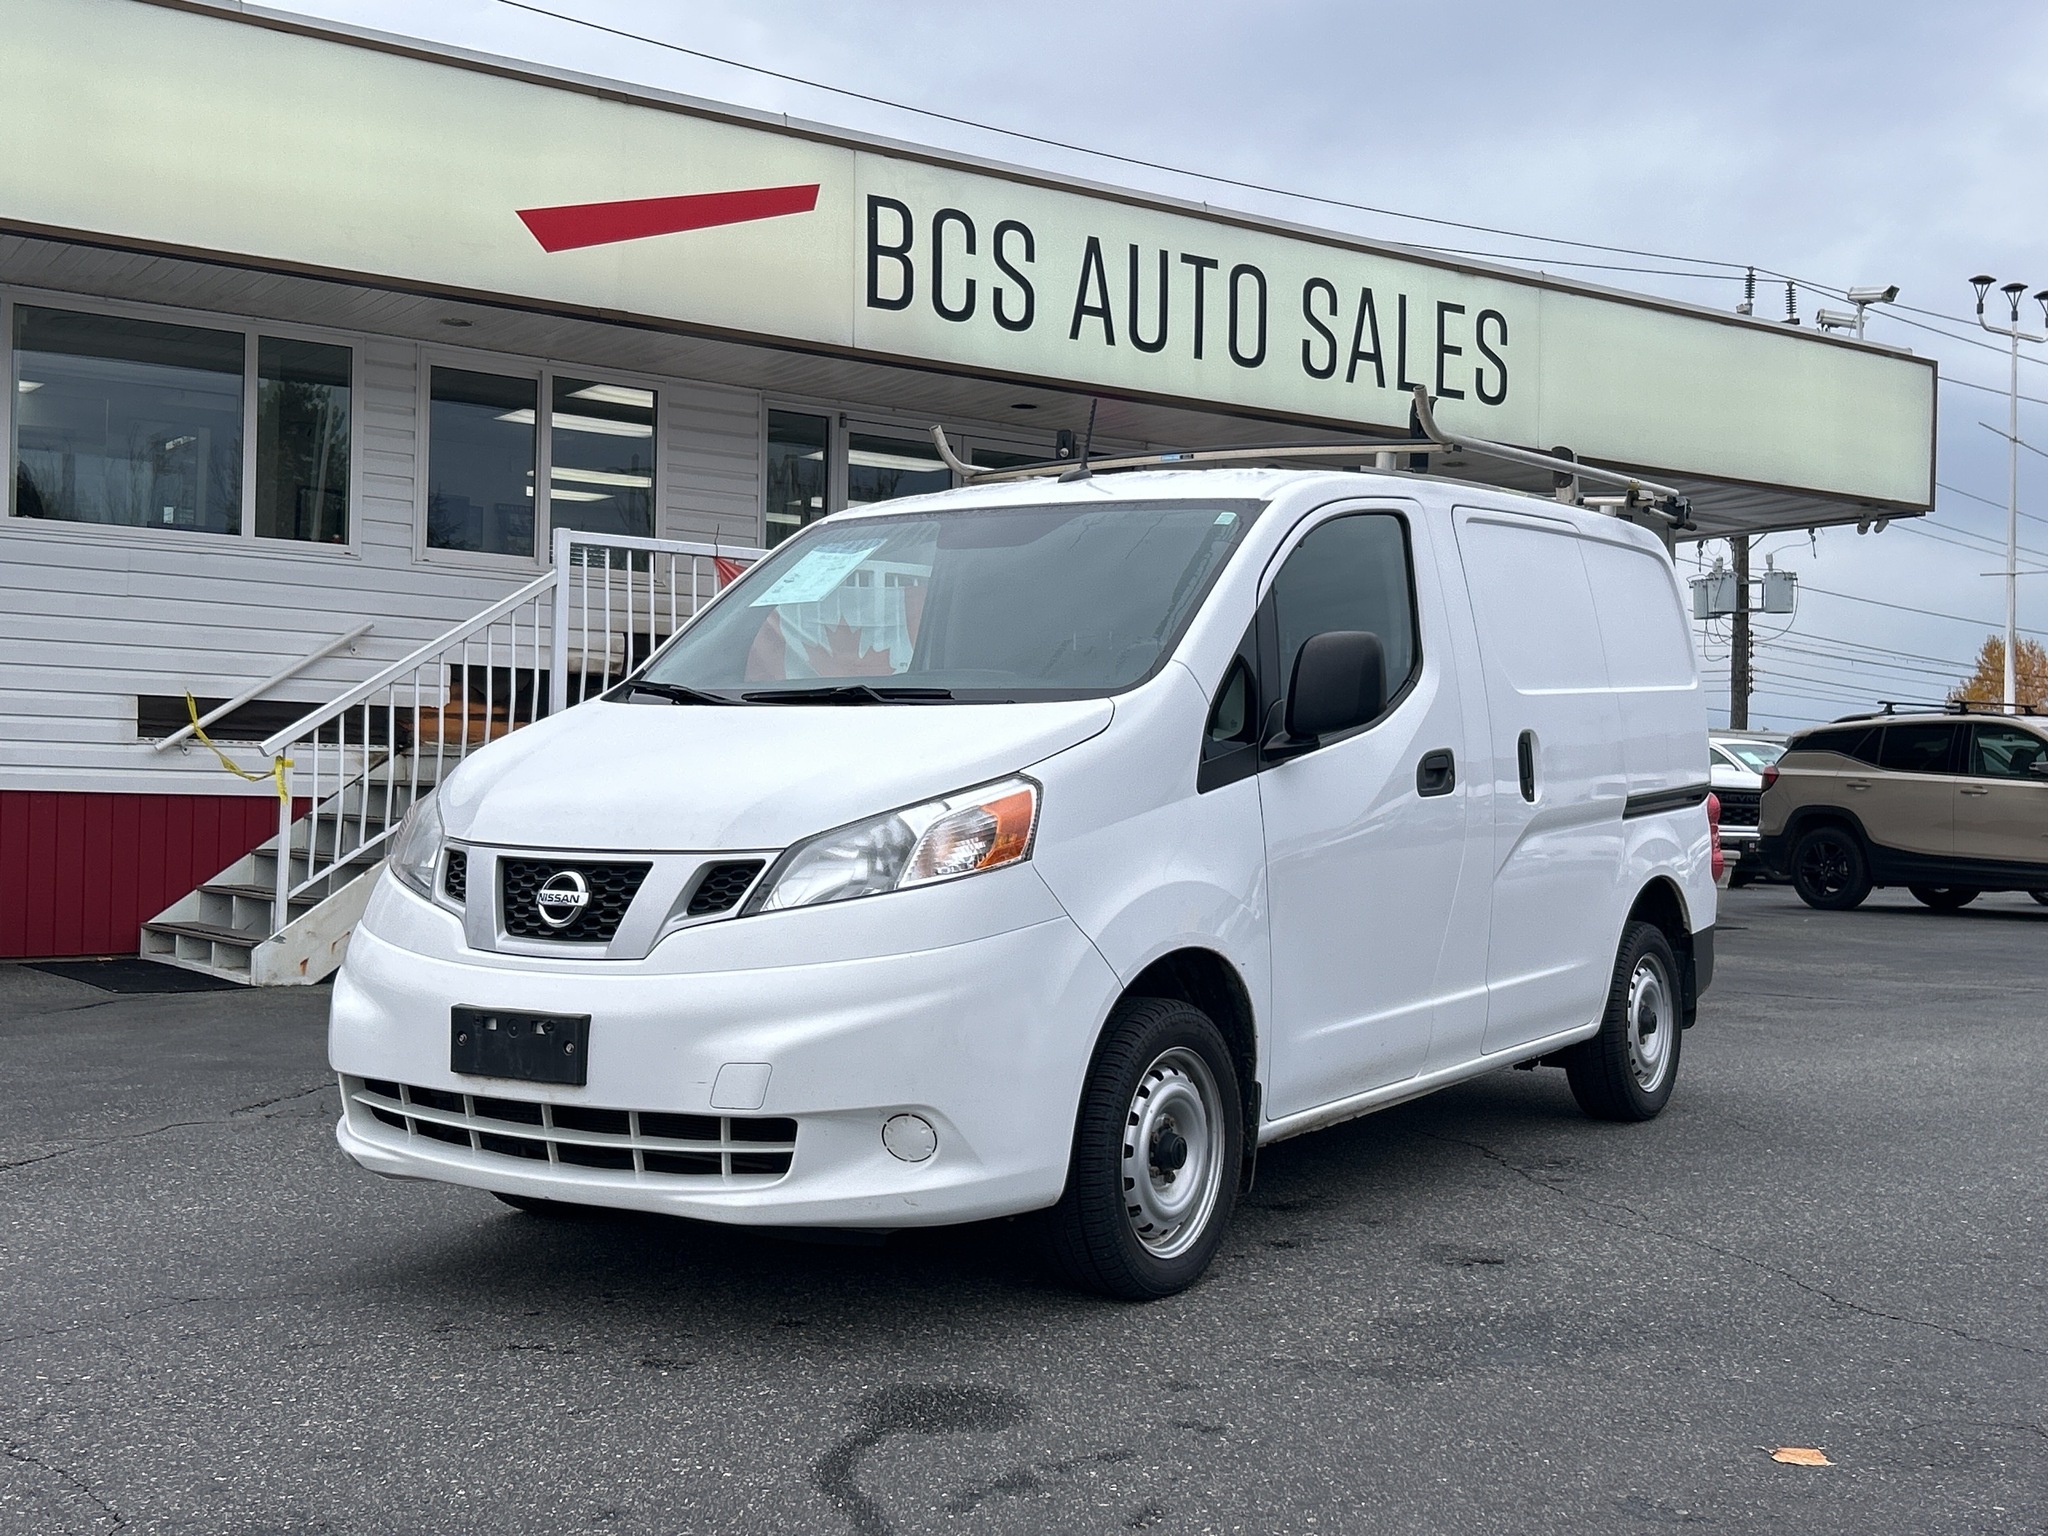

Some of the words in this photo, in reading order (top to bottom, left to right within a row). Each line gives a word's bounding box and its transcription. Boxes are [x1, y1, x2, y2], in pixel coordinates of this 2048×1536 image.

[866, 193, 1035, 332] BCS
[1069, 235, 1267, 369] AUTO
[1302, 277, 1508, 406] SALES
[539, 892, 580, 904] NISSAN
